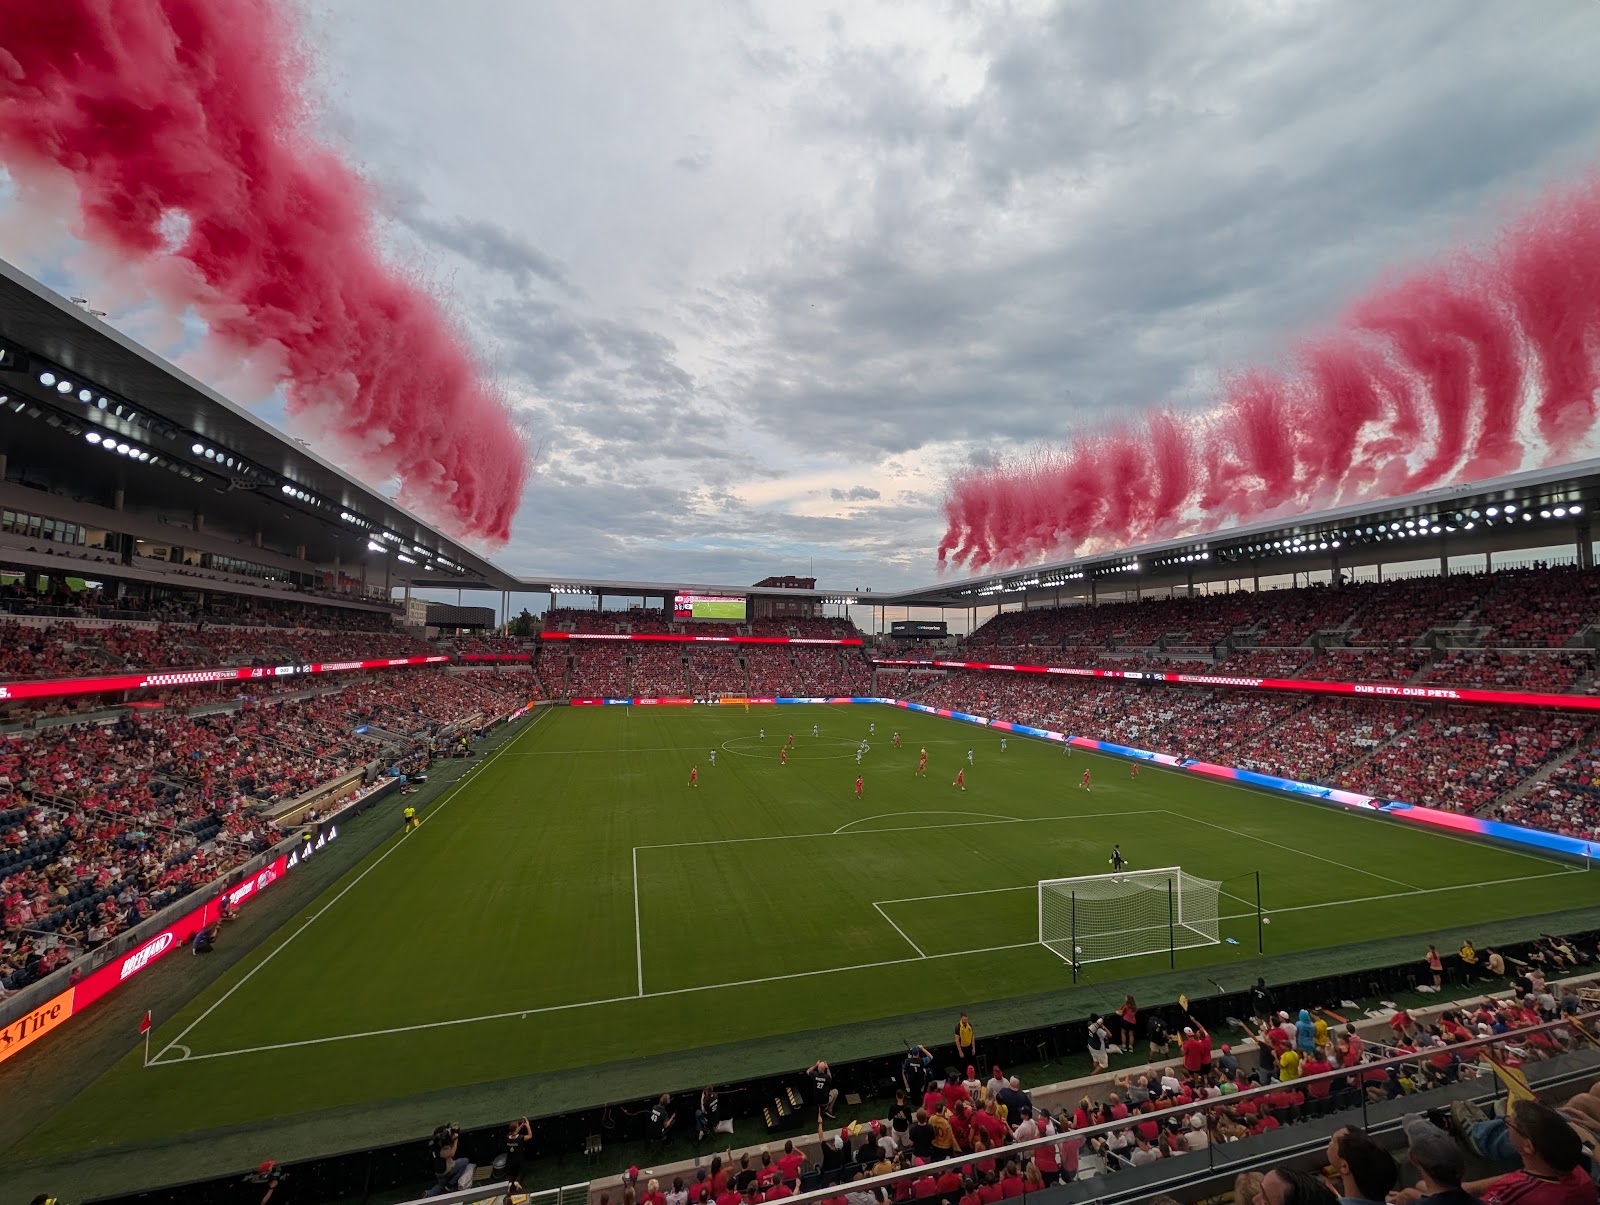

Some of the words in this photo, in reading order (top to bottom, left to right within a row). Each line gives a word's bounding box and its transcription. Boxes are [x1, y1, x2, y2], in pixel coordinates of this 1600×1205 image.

[1354, 685, 1374, 693] OUR
[1376, 686, 1401, 694] CITY.
[1403, 688, 1425, 696] OUR
[1428, 689, 1460, 698] PETS.
[121, 936, 167, 975] HOFFMANN
[14, 1004, 61, 1043] Tire
[816, 1082, 825, 1090] 27
